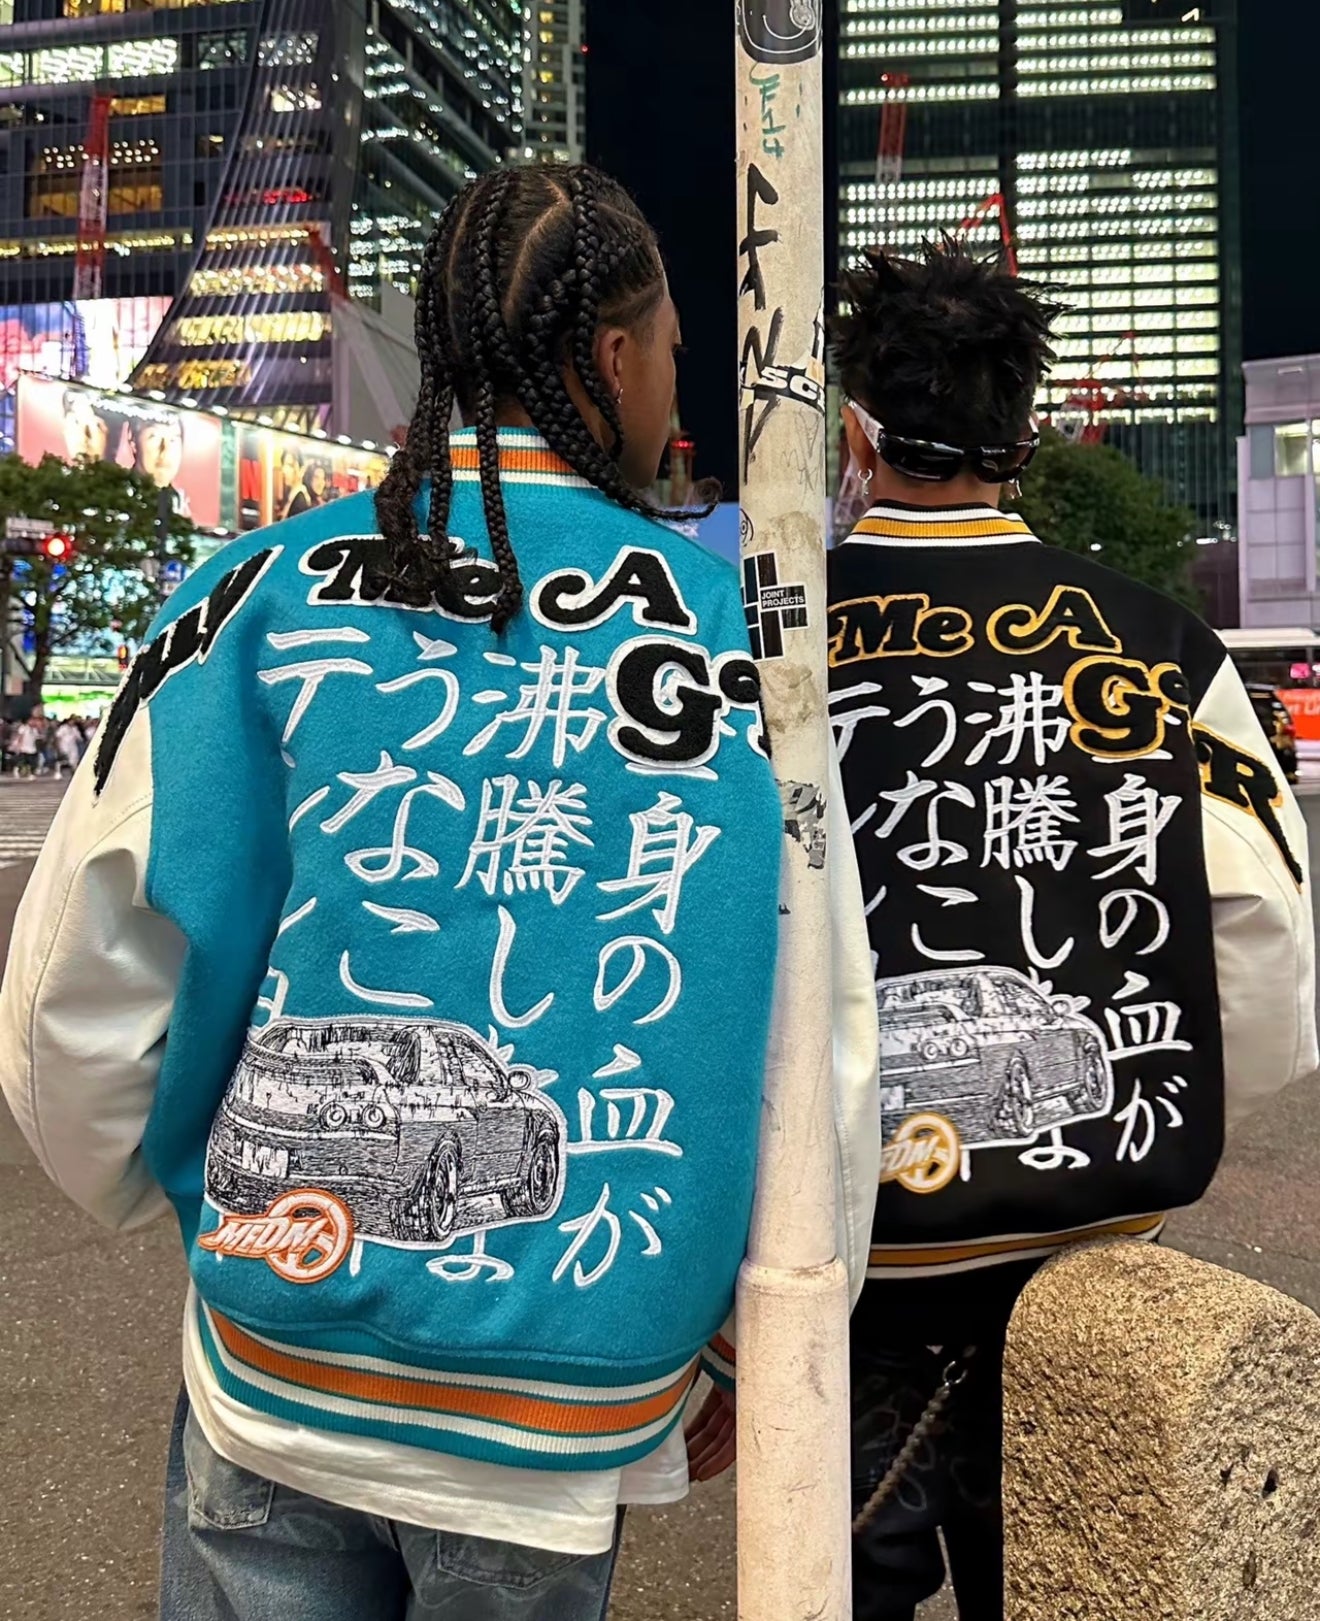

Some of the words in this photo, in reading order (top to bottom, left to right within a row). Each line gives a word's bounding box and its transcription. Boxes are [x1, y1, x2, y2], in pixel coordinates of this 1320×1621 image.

[529, 545, 697, 636] A
[761, 590, 784, 600] JOINT
[762, 596, 805, 608] PROJECTS
[827, 592, 975, 667] Me
[986, 585, 1122, 655] A
[1086, 713, 1194, 1163] 身の血が
[552, 720, 737, 1288] 身の血が
